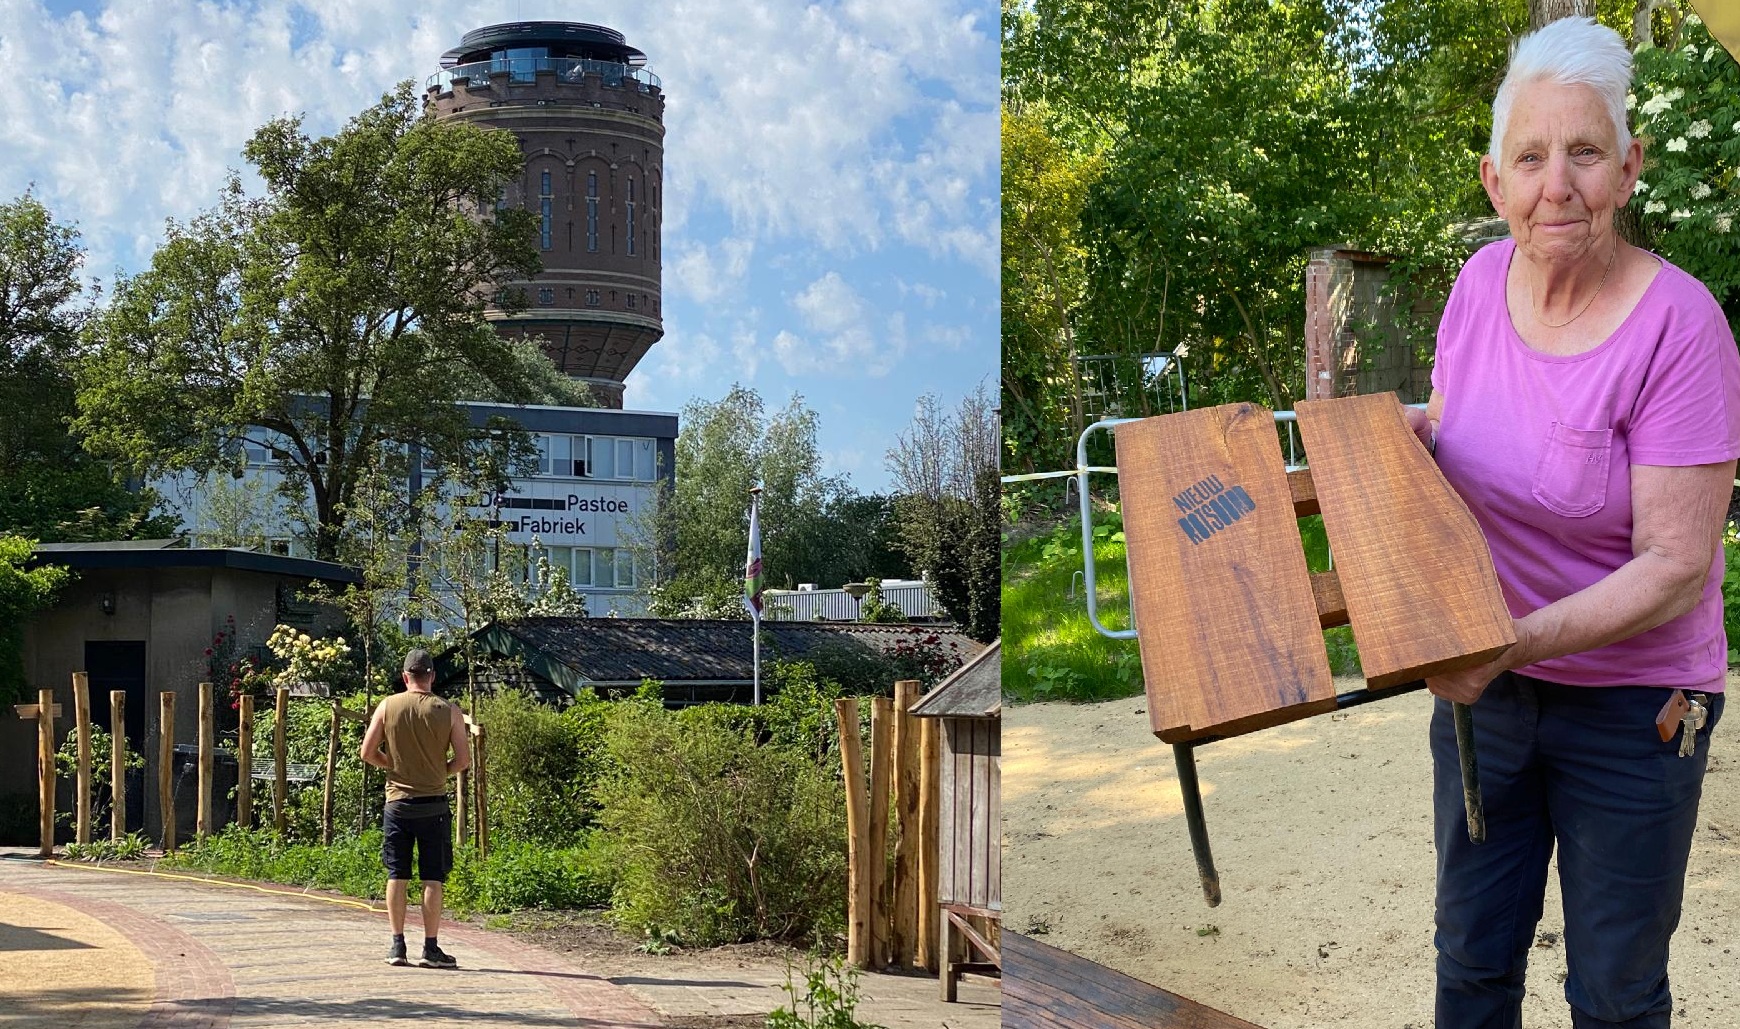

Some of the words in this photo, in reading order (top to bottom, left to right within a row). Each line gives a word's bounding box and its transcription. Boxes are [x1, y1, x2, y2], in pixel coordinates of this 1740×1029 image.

[568, 494, 628, 513] Pastoe
[1172, 474, 1224, 514] NIEUW
[520, 516, 586, 534] Fabriek
